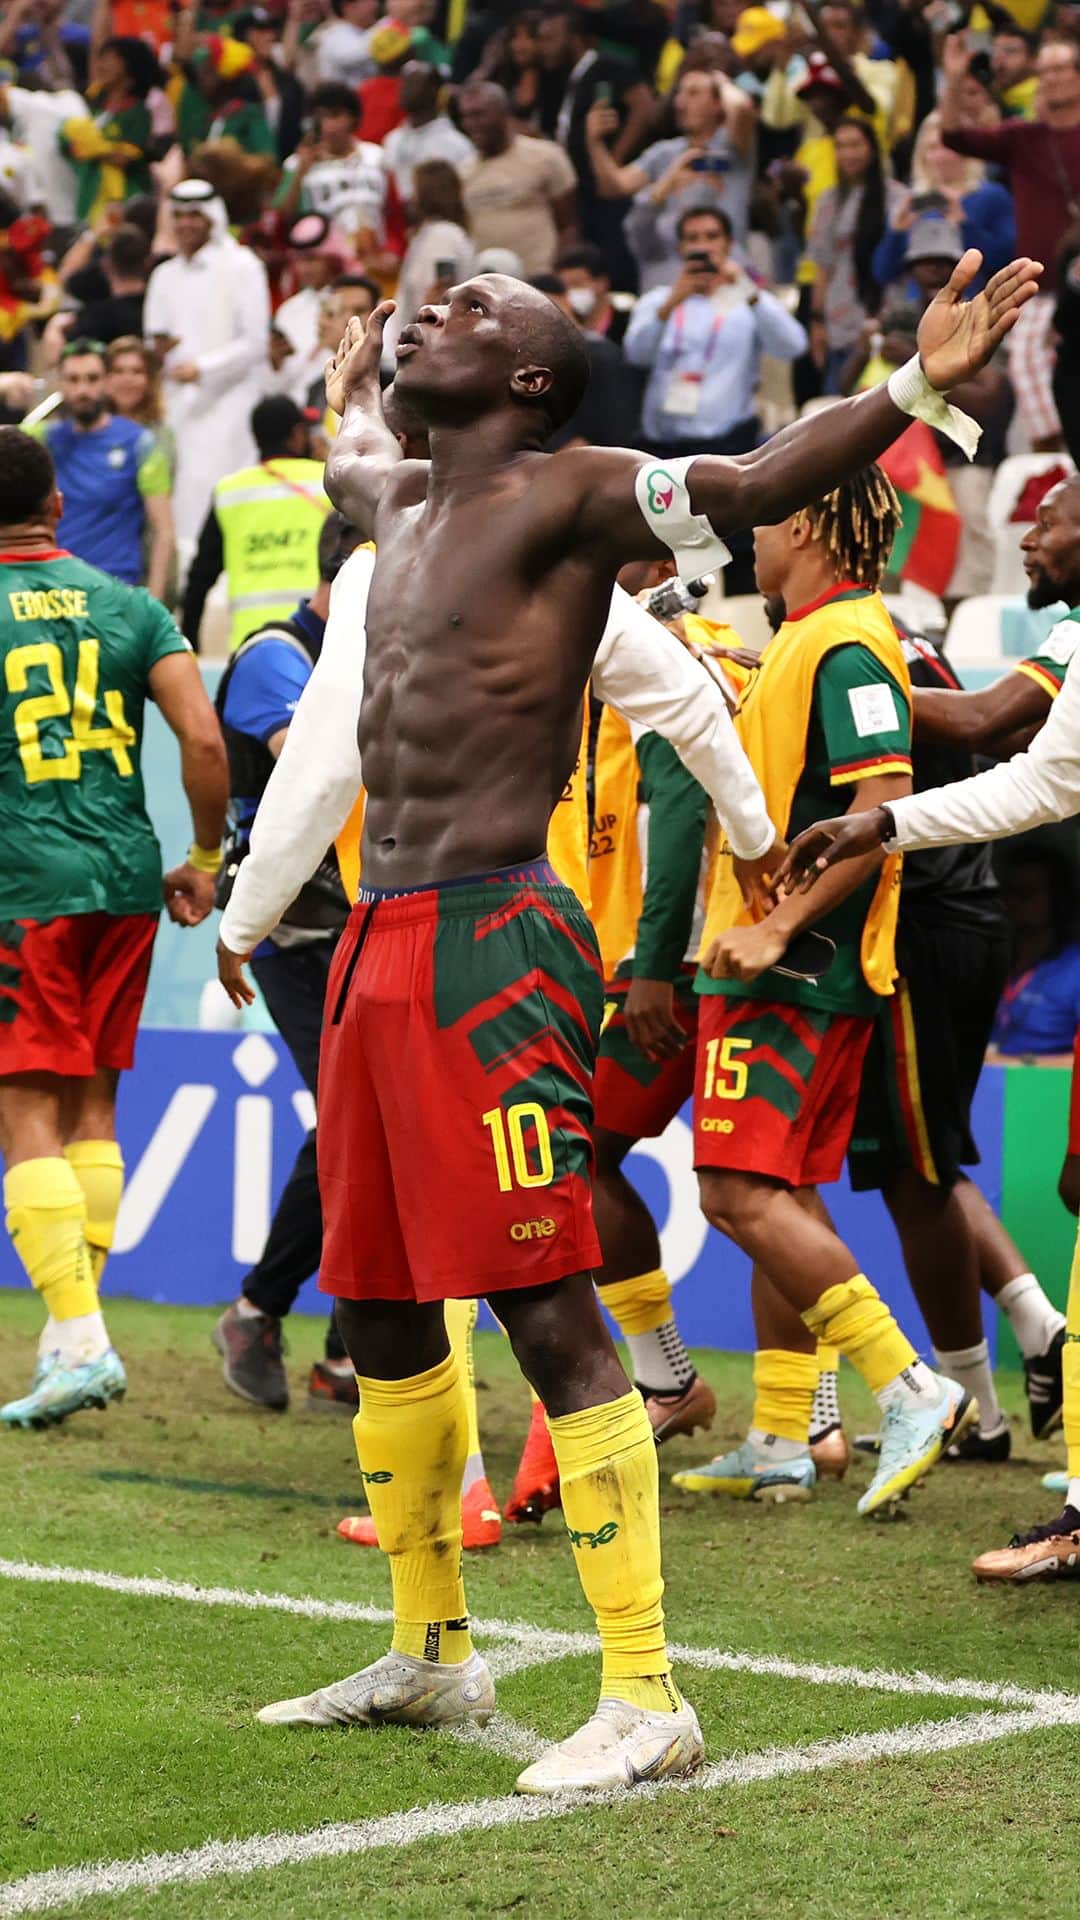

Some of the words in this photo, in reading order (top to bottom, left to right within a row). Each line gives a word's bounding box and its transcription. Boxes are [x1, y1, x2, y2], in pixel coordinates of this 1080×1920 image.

[9, 588, 90, 621] EBOSSE
[4, 638, 136, 784] 24
[594, 813, 617, 833] UP
[704, 1036, 752, 1100] 15
[700, 1117, 735, 1134] one
[482, 1102, 555, 1192] 10
[510, 1216, 556, 1241] one
[361, 1470, 394, 1484] ne
